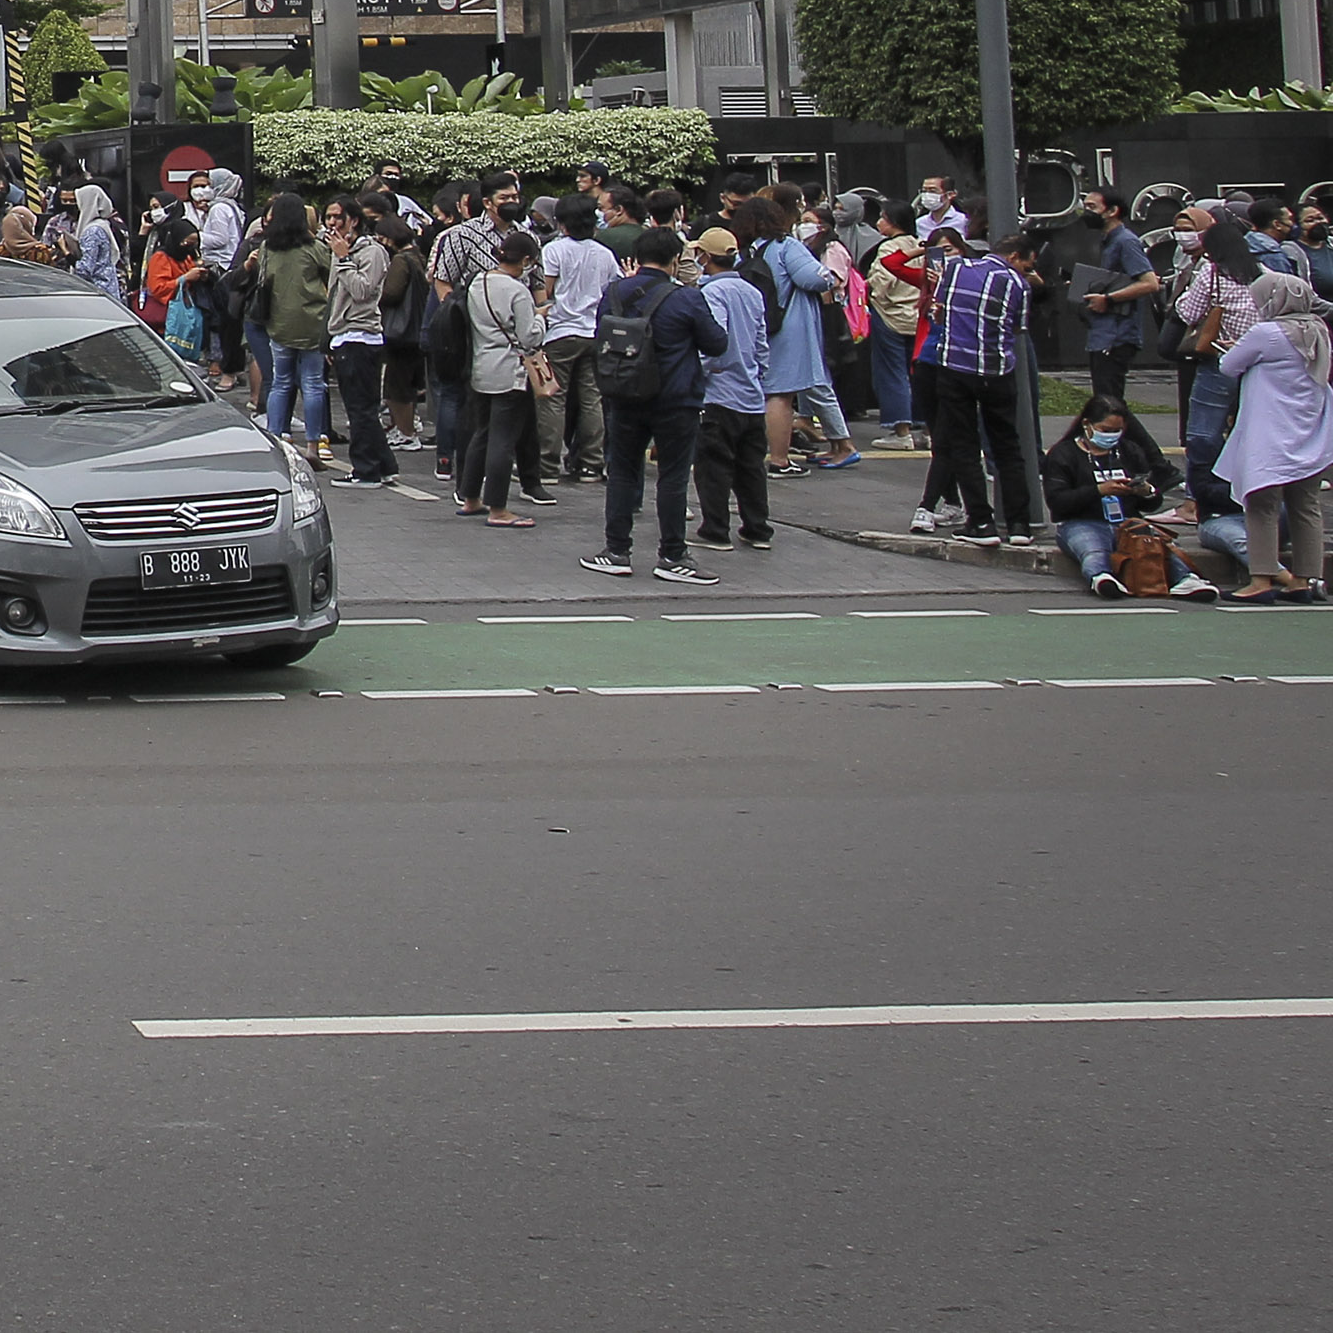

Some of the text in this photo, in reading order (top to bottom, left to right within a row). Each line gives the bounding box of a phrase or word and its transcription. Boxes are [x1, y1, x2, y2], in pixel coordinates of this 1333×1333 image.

[143, 547, 249, 576] B 888 JYK
